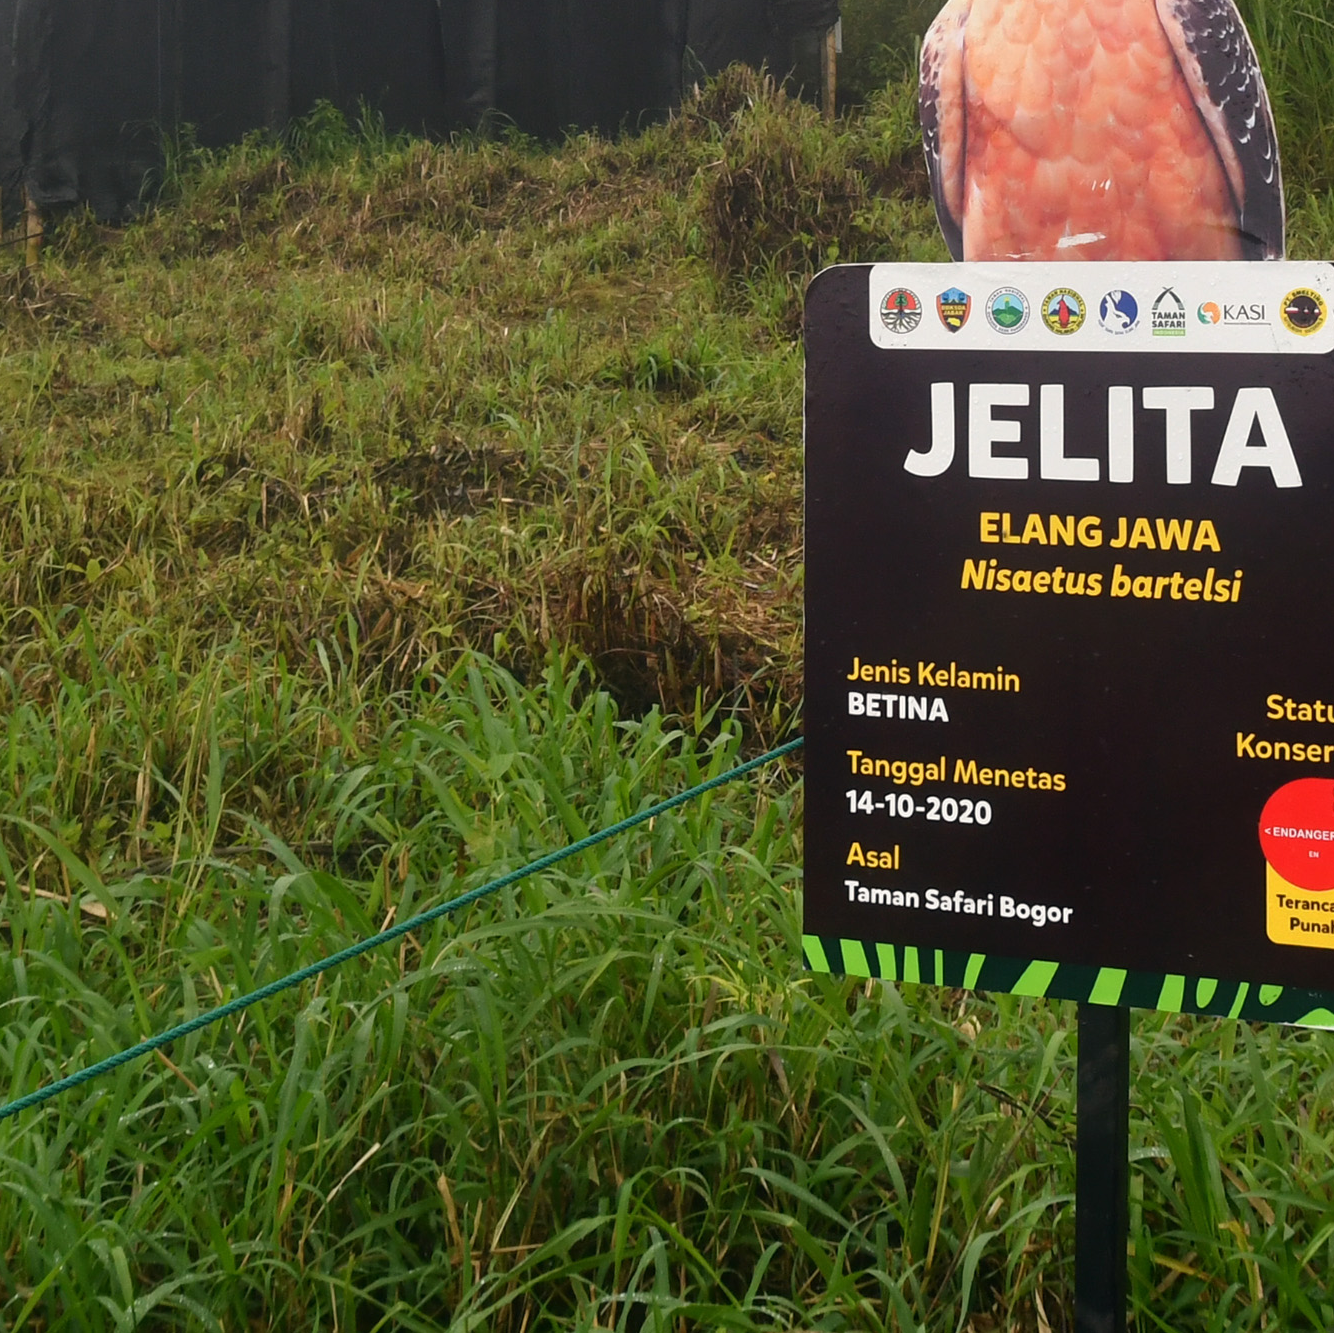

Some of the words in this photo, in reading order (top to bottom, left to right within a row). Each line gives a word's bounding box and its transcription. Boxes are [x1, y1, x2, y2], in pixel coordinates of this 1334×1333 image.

[1152, 312, 1185, 320] TAMAN
[1152, 320, 1185, 328] SAFARI
[1223, 304, 1265, 321] KASI
[904, 382, 1302, 488] JELITA
[980, 512, 1102, 547] ELANG
[1110, 517, 1221, 552] JAWA
[961, 559, 1102, 596] Nisaetus
[1111, 564, 1243, 602] bartelsi
[847, 657, 910, 684] Jenis
[918, 662, 1019, 692] Kelamin
[849, 692, 949, 722] BETINA
[847, 750, 945, 786] Tanggal
[954, 759, 1066, 791] Menetas
[846, 790, 991, 824] 14-10-2020
[847, 842, 899, 869] Asal
[1308, 850, 1320, 858] EN
[845, 880, 919, 908] Taman
[925, 889, 993, 916] Safari
[1000, 896, 1073, 926] Bogor
